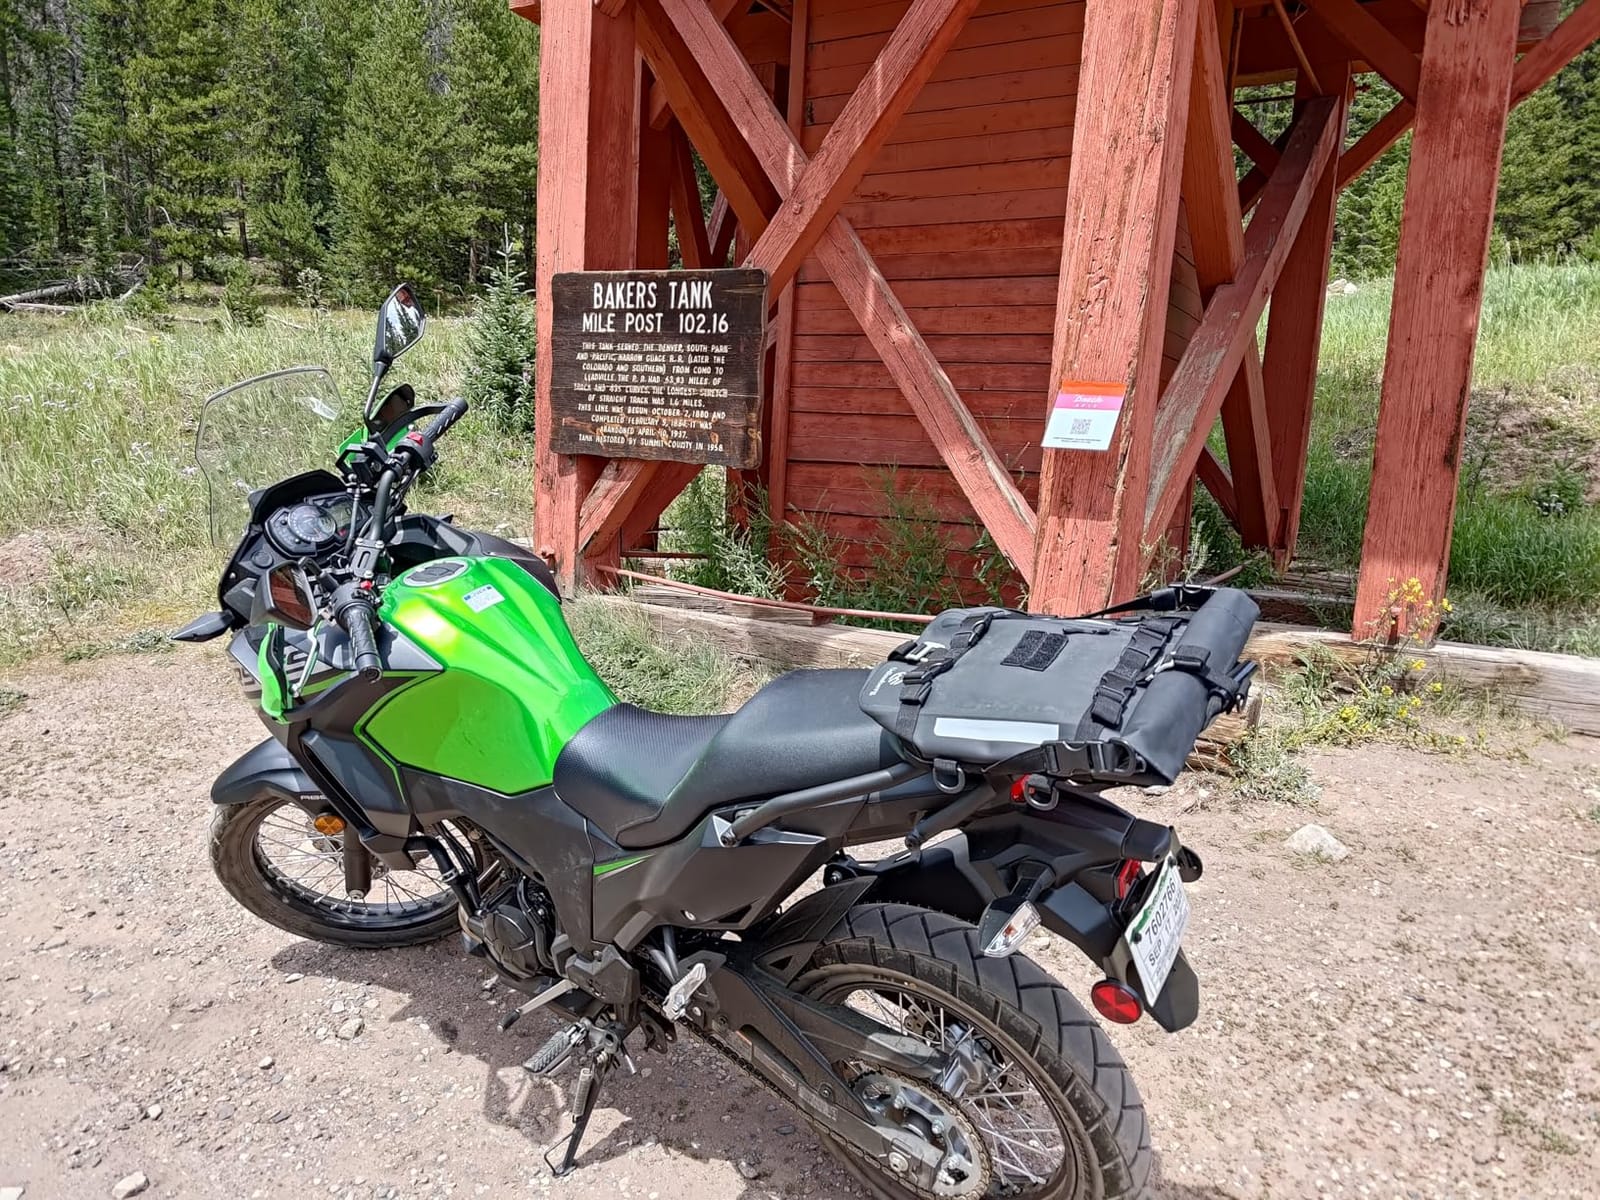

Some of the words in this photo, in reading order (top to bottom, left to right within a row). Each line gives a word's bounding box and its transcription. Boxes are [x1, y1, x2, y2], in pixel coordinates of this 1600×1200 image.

[593, 281, 657, 310] BAKERS
[669, 281, 713, 309] TANK
[582, 312, 615, 333] MILE
[625, 313, 663, 333] POST
[679, 313, 729, 334] 102.16
[582, 342, 595, 350] THIS
[598, 343, 614, 351] TANK
[617, 343, 639, 351] SERVED
[643, 344, 654, 352] THE
[687, 344, 708, 352] SOUTH
[711, 345, 728, 353] PARK
[576, 352, 588, 360] AND
[618, 353, 643, 361] NARROW
[688, 353, 709, 364] (LATER
[713, 356, 725, 364] THE
[582, 363, 613, 371] COLORADO
[616, 363, 629, 372] AND
[632, 364, 666, 375] SOUTHERN)
[672, 366, 690, 374] FROM
[693, 366, 711, 374] COMO
[715, 366, 724, 375] TO
[618, 374, 629, 382] THE
[648, 376, 660, 384] HAD
[712, 377, 722, 386] OF
[594, 384, 606, 392] AND
[652, 386, 665, 395] THE
[667, 387, 695, 396] LONGEST
[699, 388, 728, 398] STRETCH
[588, 394, 596, 402] OF
[599, 395, 627, 403] STRAIGHT
[630, 396, 648, 404] TRACK
[652, 397, 665, 405] WAS
[682, 399, 705, 408] MILES.
[578, 403, 591, 411] THIS
[595, 404, 609, 412] LINE
[612, 406, 624, 414] WAS
[627, 406, 648, 415] BEGUN
[651, 408, 680, 416] OCTOBER
[712, 411, 726, 419] AND
[591, 415, 624, 424] COMPLETED
[628, 416, 659, 426] FEBRUARY
[700, 421, 713, 429] WAS
[601, 425, 634, 435] ABANDONED
[638, 428, 655, 436] APRIL
[578, 434, 593, 442] TANK
[596, 435, 626, 444] RESTORED
[628, 437, 637, 446] BY
[640, 438, 664, 447] SUMMIT
[668, 440, 693, 450] COUNTY
[696, 442, 704, 451] IN
[1145, 877, 1176, 945] 7602766
[1148, 939, 1162, 967] SEP
